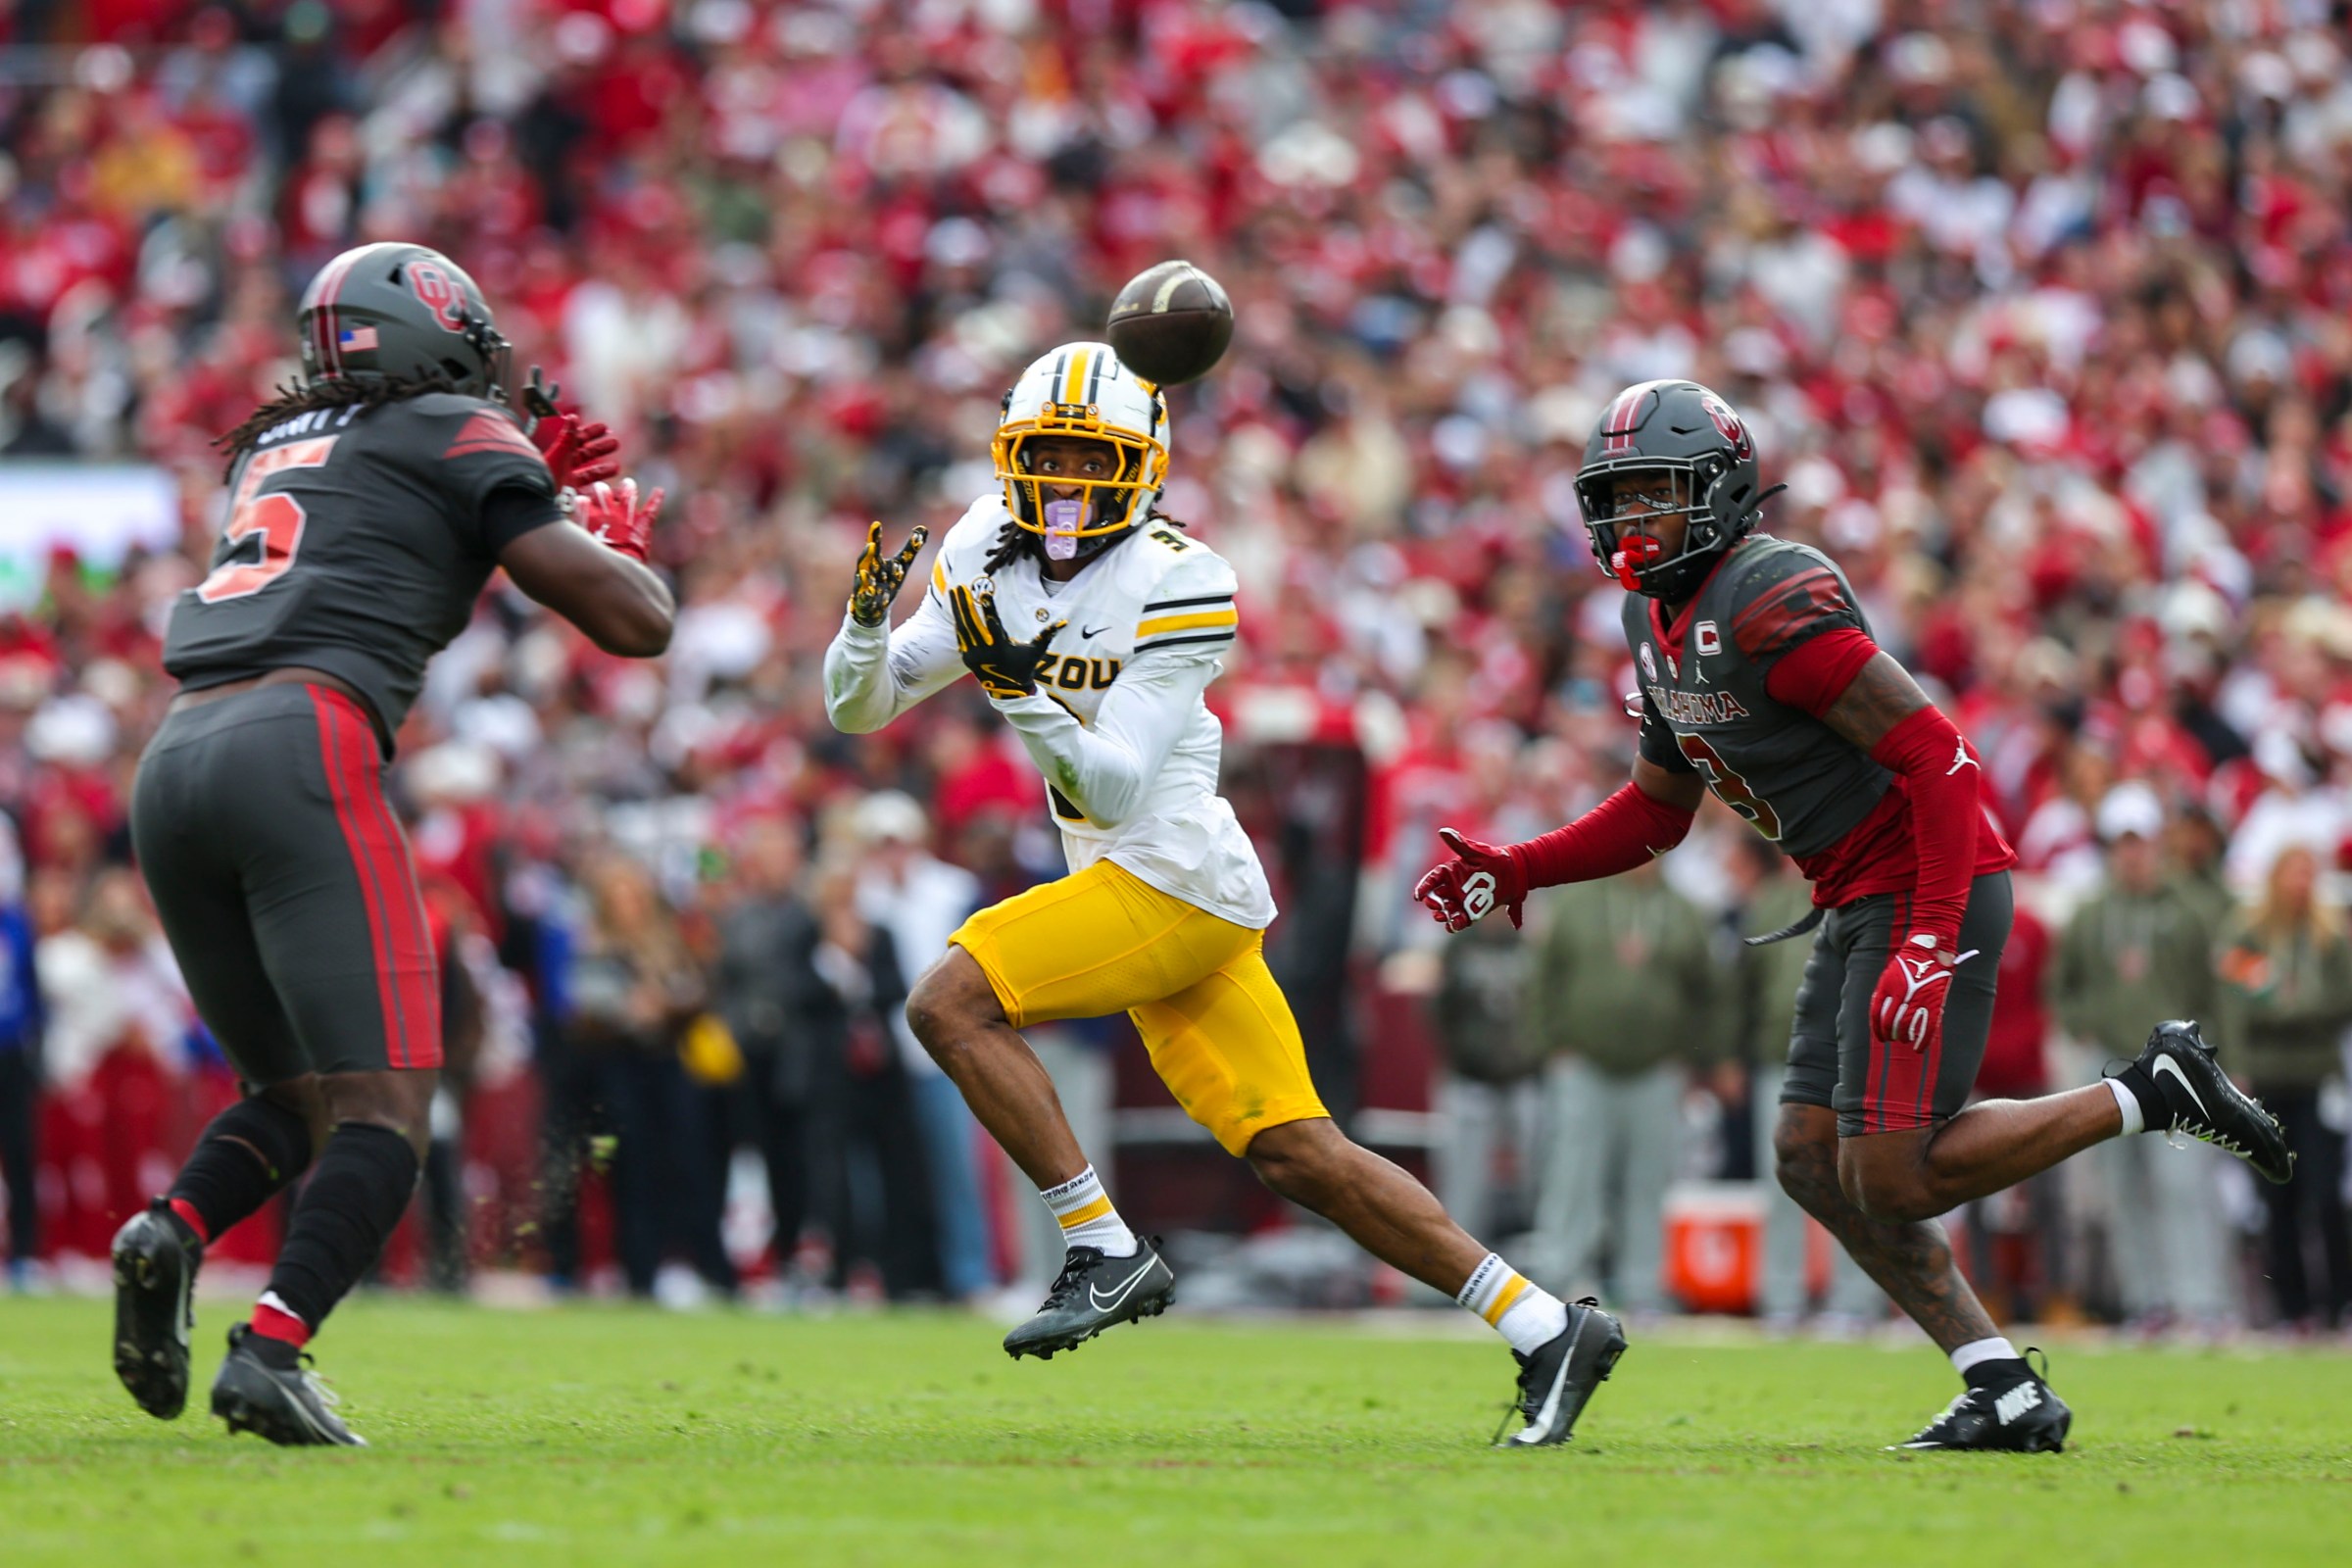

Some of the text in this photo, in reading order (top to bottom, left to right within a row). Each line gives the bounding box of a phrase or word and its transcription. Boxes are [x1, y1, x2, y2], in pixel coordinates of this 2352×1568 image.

[405, 260, 472, 334] OU
[1113, 463, 1141, 503] MIZOU
[197, 434, 341, 604] 5
[1149, 529, 1190, 553] 3
[1694, 620, 1722, 656] C
[1035, 651, 1123, 691] ZOU
[1676, 732, 1782, 841] 3
[1993, 1381, 2042, 1426] NIKE
